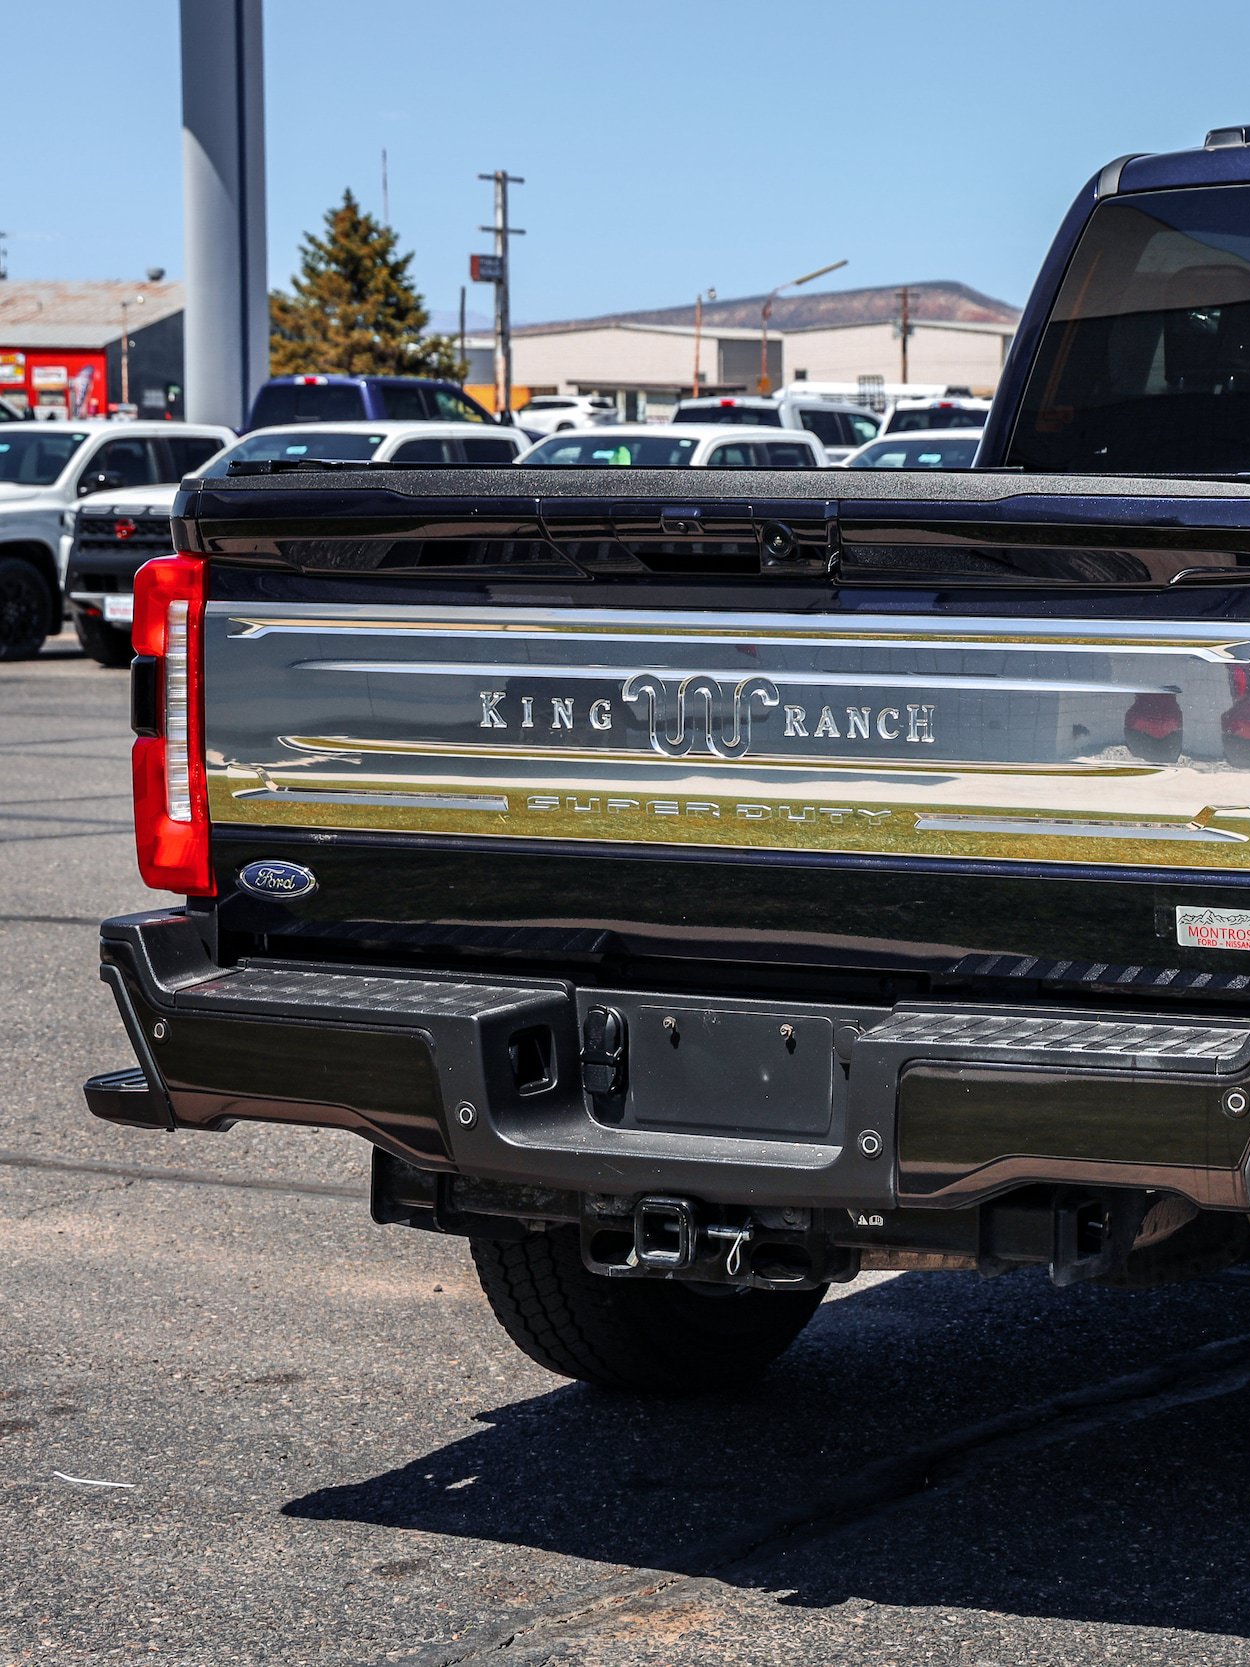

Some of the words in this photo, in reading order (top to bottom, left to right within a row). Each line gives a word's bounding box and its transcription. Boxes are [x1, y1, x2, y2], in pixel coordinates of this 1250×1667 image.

[479, 690, 614, 731] KING
[783, 703, 936, 743] RANCH
[527, 795, 721, 819] SUPER
[735, 803, 893, 826] DUTY
[255, 867, 295, 889] Ford
[1197, 938, 1217, 947] FORD
